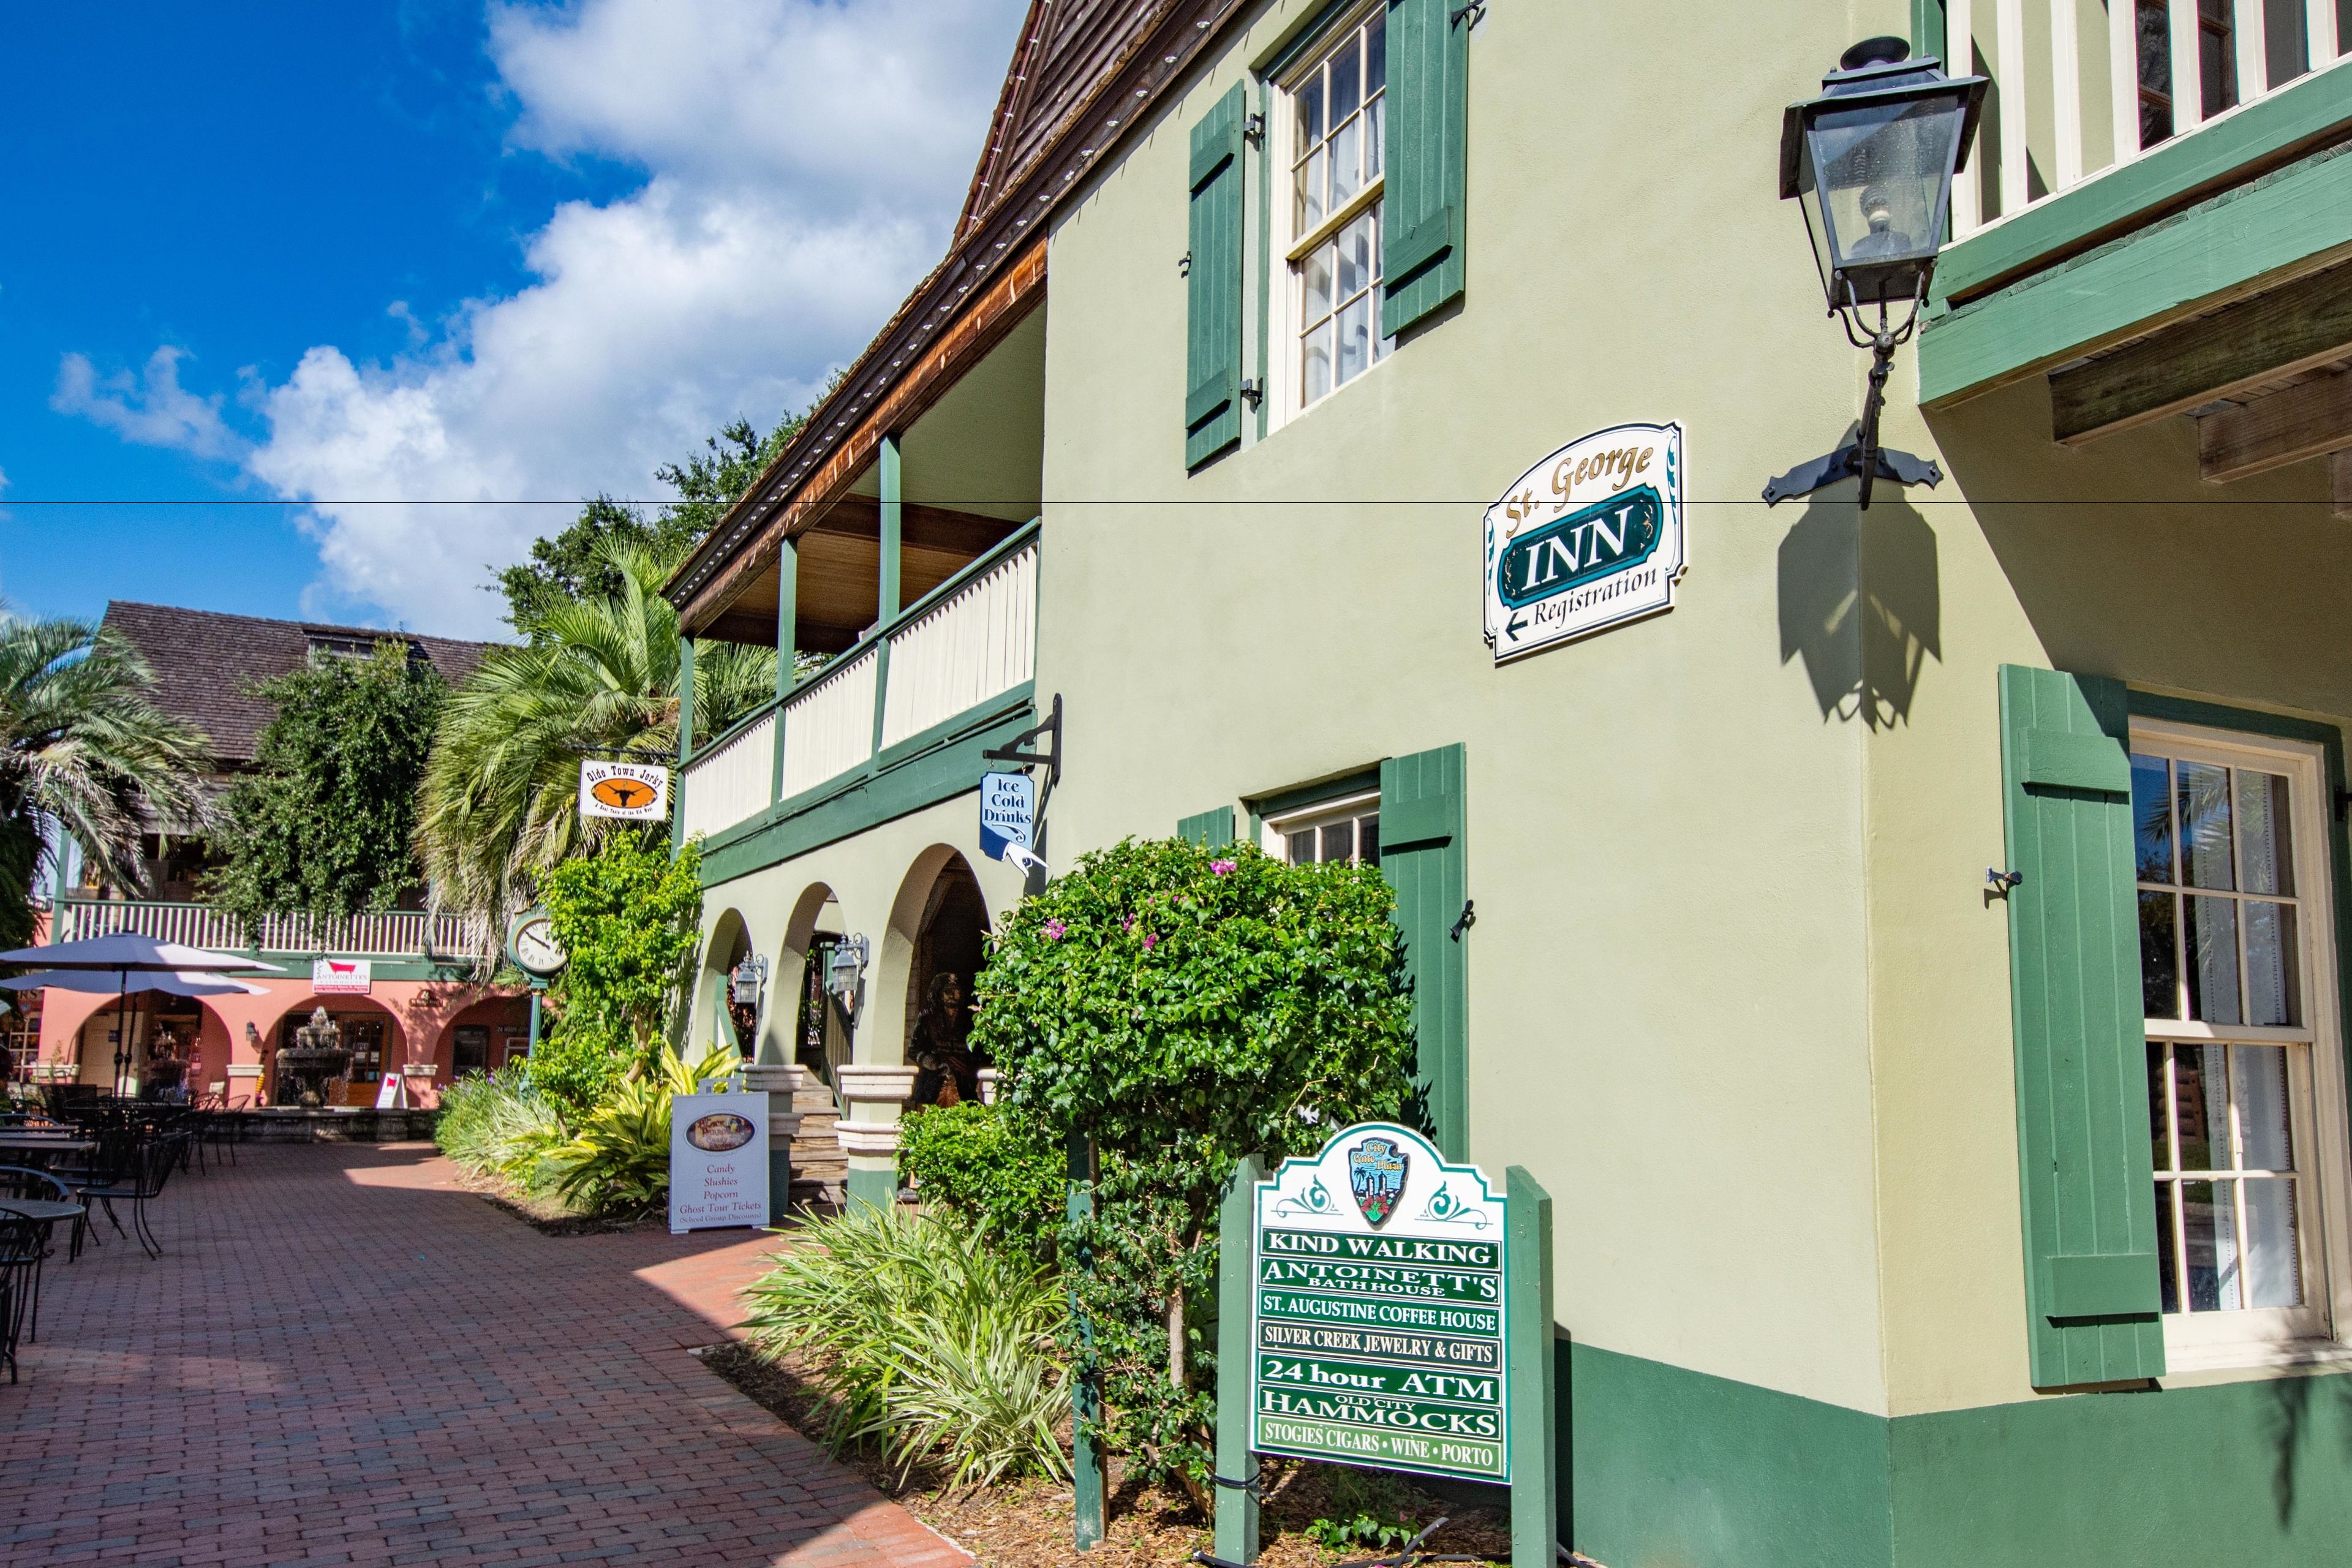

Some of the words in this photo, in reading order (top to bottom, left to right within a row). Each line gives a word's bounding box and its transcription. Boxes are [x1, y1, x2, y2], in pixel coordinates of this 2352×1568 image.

[1506, 488, 1539, 538] St.
[1552, 447, 1654, 513] George
[1521, 505, 1634, 591] INN
[1534, 568, 1656, 628] Registration
[587, 769, 606, 782] Olde
[611, 766, 634, 776] Town
[640, 769, 663, 788] Jerky
[998, 778, 1019, 792] Ice
[992, 794, 1025, 808] Cold
[984, 809, 1031, 823] Drinks
[1353, 1153, 1375, 1164] Gate
[1366, 1142, 1387, 1156] City
[707, 1164, 735, 1174] Candy
[1376, 1159, 1403, 1170] Plaza
[704, 1177, 737, 1186] Slushies
[704, 1191, 738, 1200] Popcorn
[680, 1205, 704, 1214] Ghost
[708, 1204, 729, 1212] Tour
[731, 1201, 761, 1210] Tickets
[1268, 1232, 1340, 1253] KIND
[1346, 1238, 1491, 1264] WALKING
[1263, 1261, 1496, 1298] ANTOINETT'S
[1264, 1295, 1285, 1311] ST.
[1288, 1298, 1376, 1320] AUGUSTINE
[1379, 1305, 1436, 1325] COFFEE
[1440, 1311, 1495, 1331] HOUSE
[1265, 1326, 1311, 1346] SILVER
[1314, 1332, 1361, 1350] CREEK
[1363, 1335, 1431, 1357] JEWELRY
[1435, 1344, 1446, 1358] &
[1450, 1343, 1492, 1363] GIFTS
[1265, 1360, 1303, 1380] 24
[1309, 1363, 1386, 1389] hour
[1398, 1373, 1494, 1401] ATM
[1335, 1395, 1371, 1406] OLD
[1374, 1399, 1416, 1411] CITY
[1262, 1390, 1496, 1436] HAMMOCKS
[1265, 1422, 1323, 1445] STOGIES
[1326, 1430, 1379, 1452] CIGARS
[1391, 1437, 1430, 1458] WINE
[1441, 1443, 1493, 1466] PORTO
